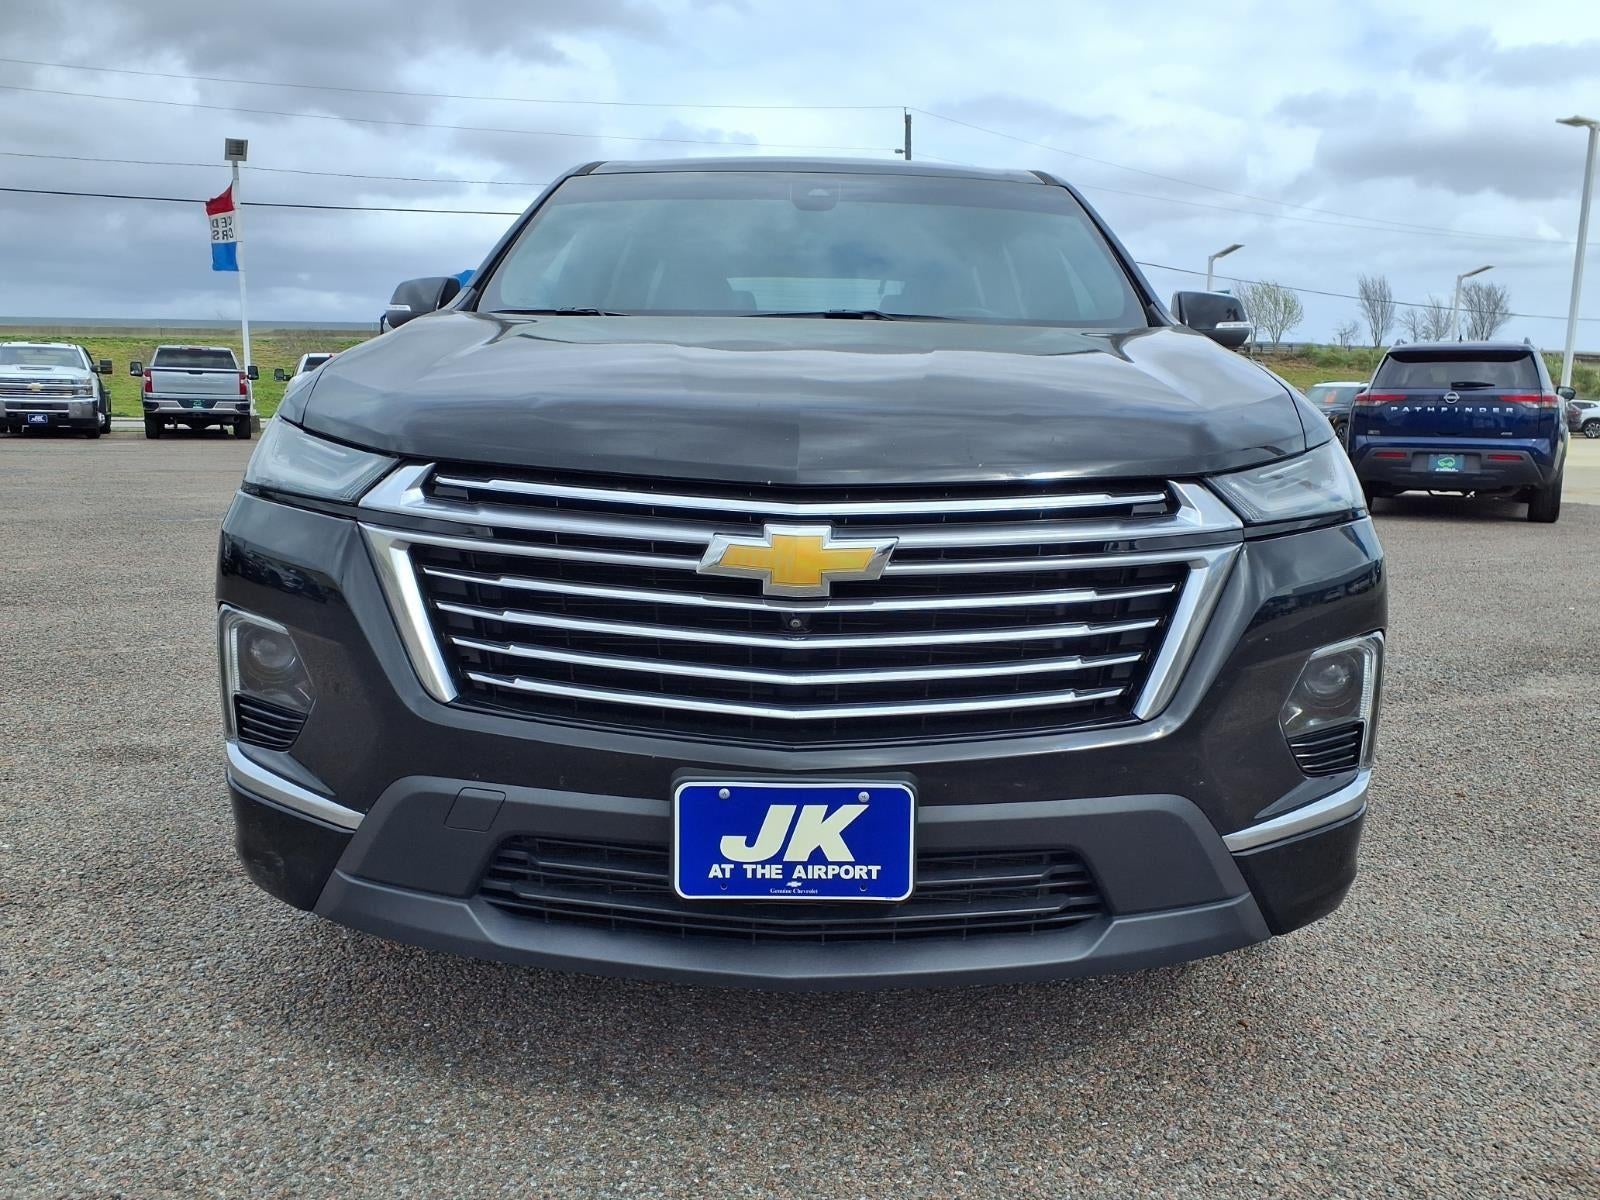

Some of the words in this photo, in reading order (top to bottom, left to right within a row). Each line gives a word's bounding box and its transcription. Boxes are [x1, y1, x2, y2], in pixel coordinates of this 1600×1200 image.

[719, 804, 870, 863] JK
[708, 864, 734, 879] AT
[743, 864, 783, 879] THE
[792, 864, 881, 880] AIRPORT
